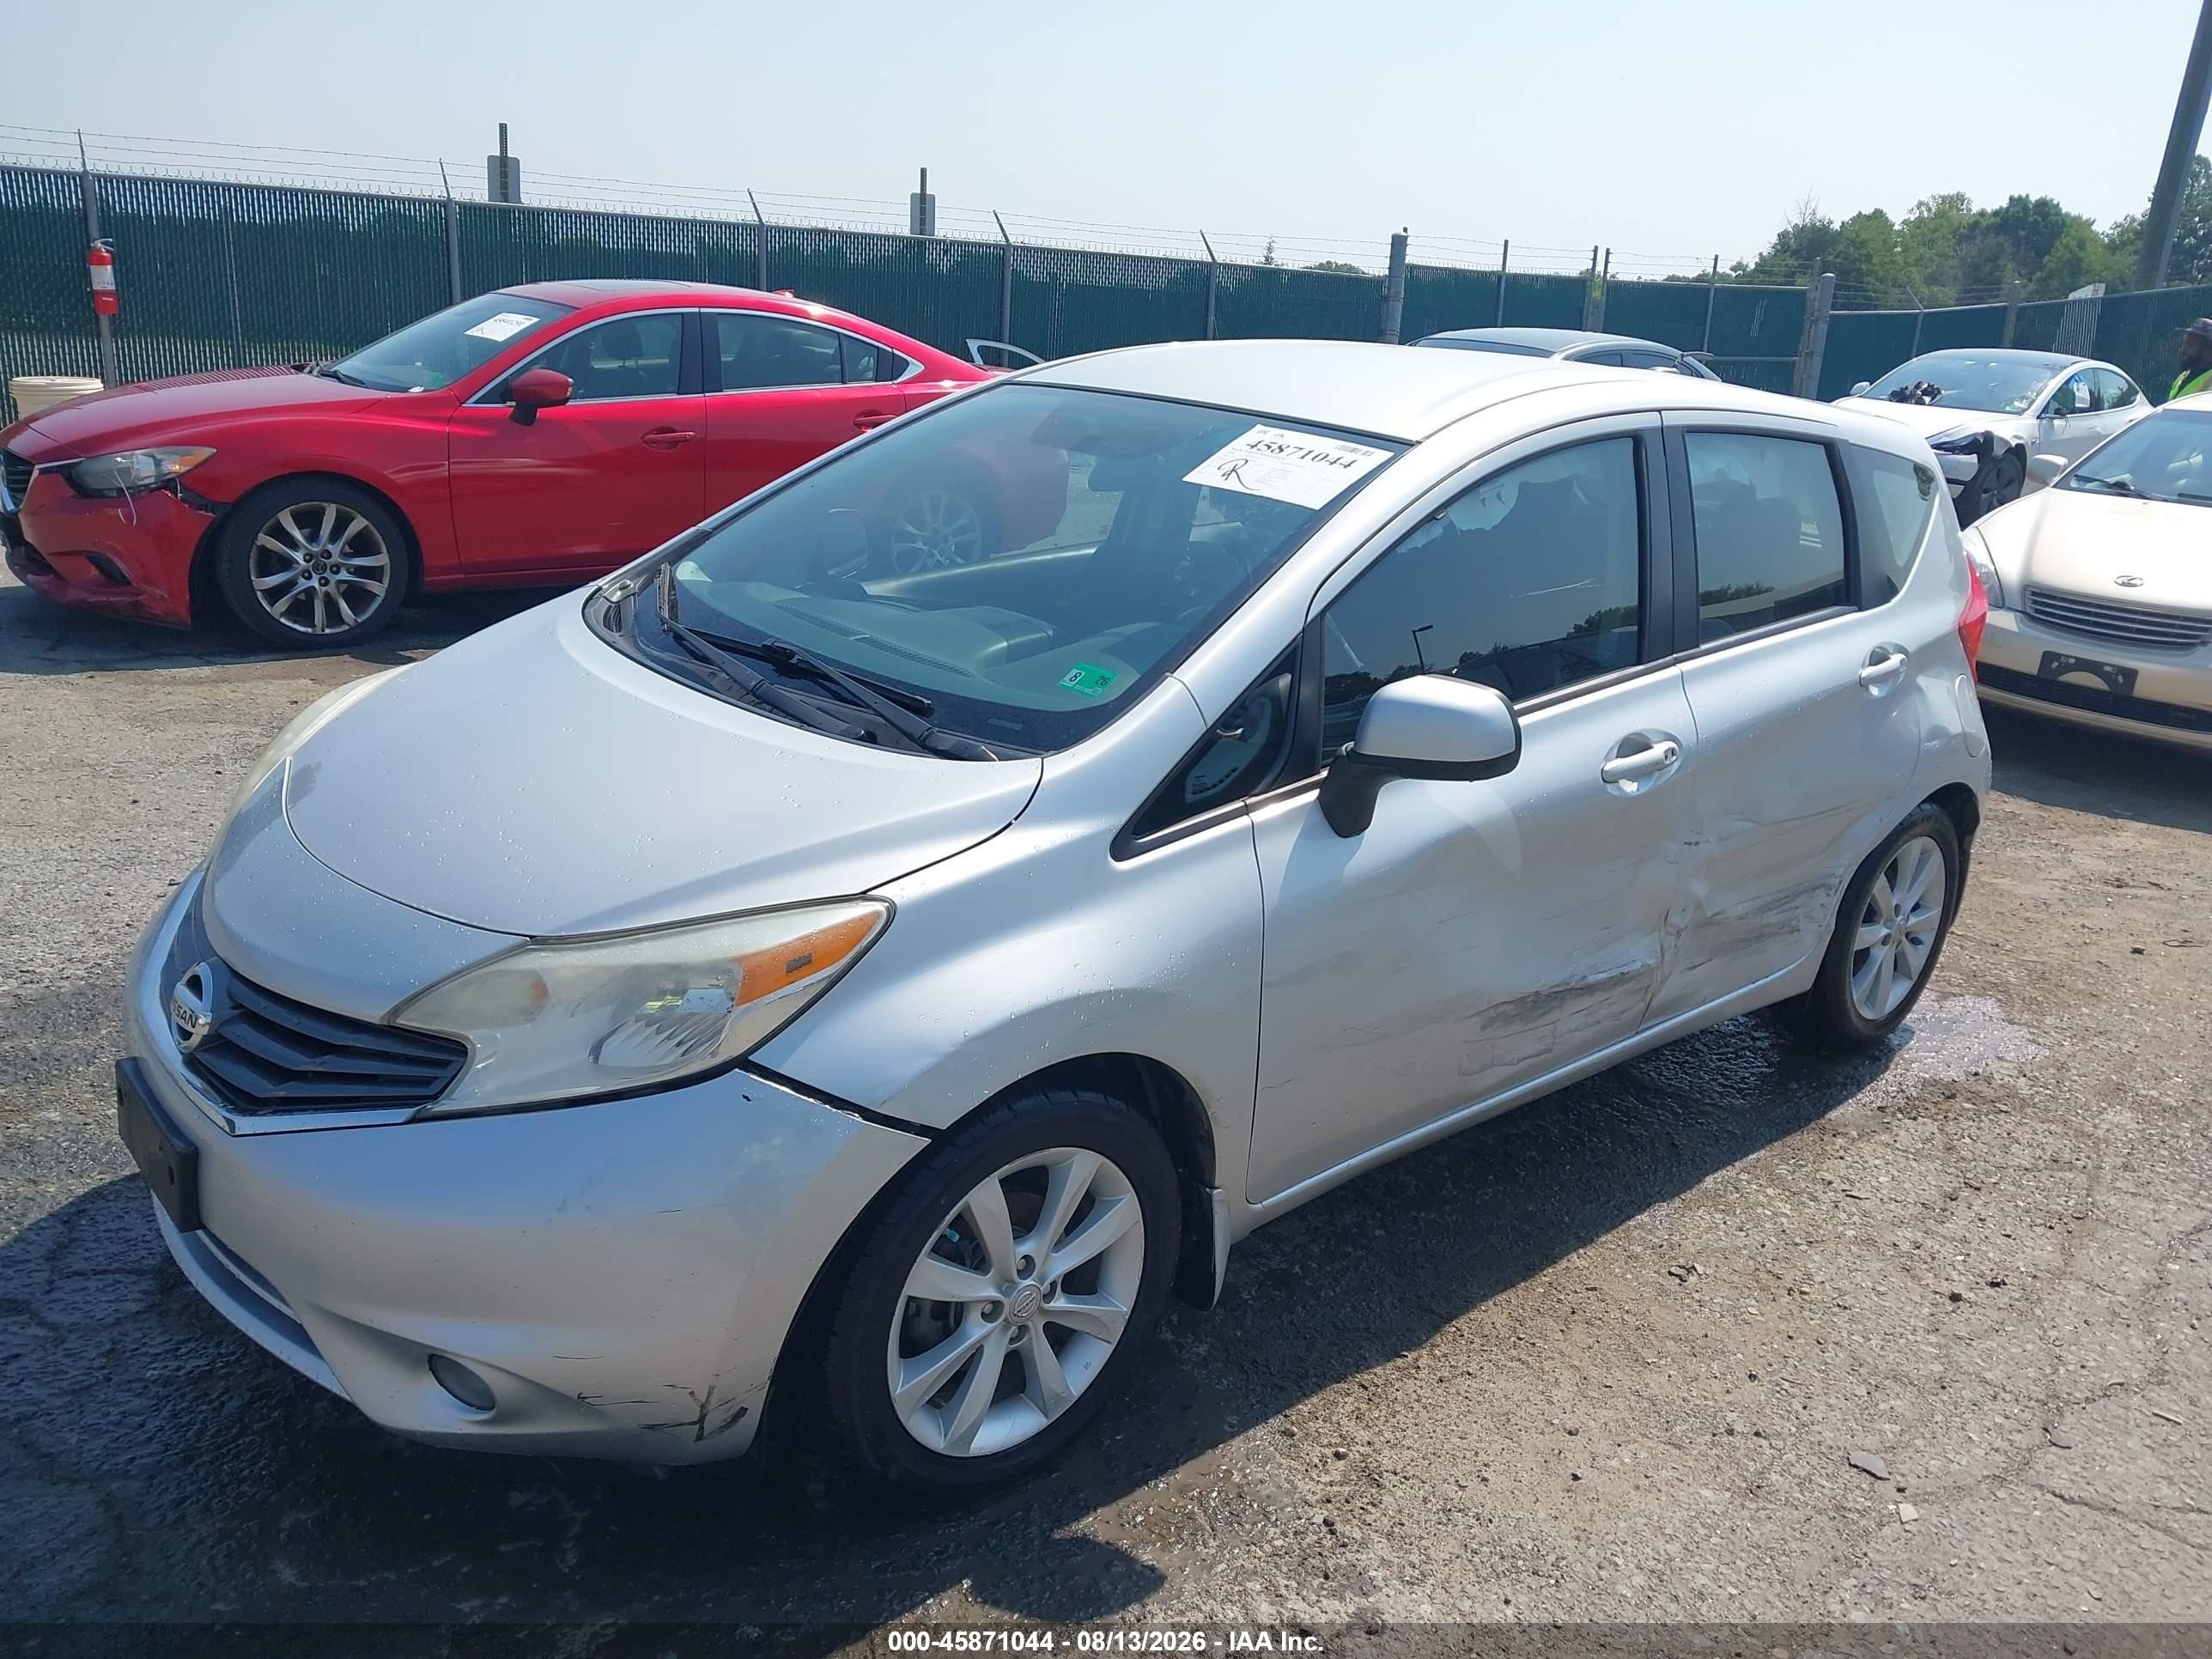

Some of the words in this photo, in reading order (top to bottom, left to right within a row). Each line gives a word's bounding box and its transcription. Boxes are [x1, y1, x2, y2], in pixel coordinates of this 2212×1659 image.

[1245, 439, 1358, 470] 45871044
[1068, 672, 1082, 683] 8
[1095, 675, 1111, 686] 26
[171, 999, 198, 1029] SSAN
